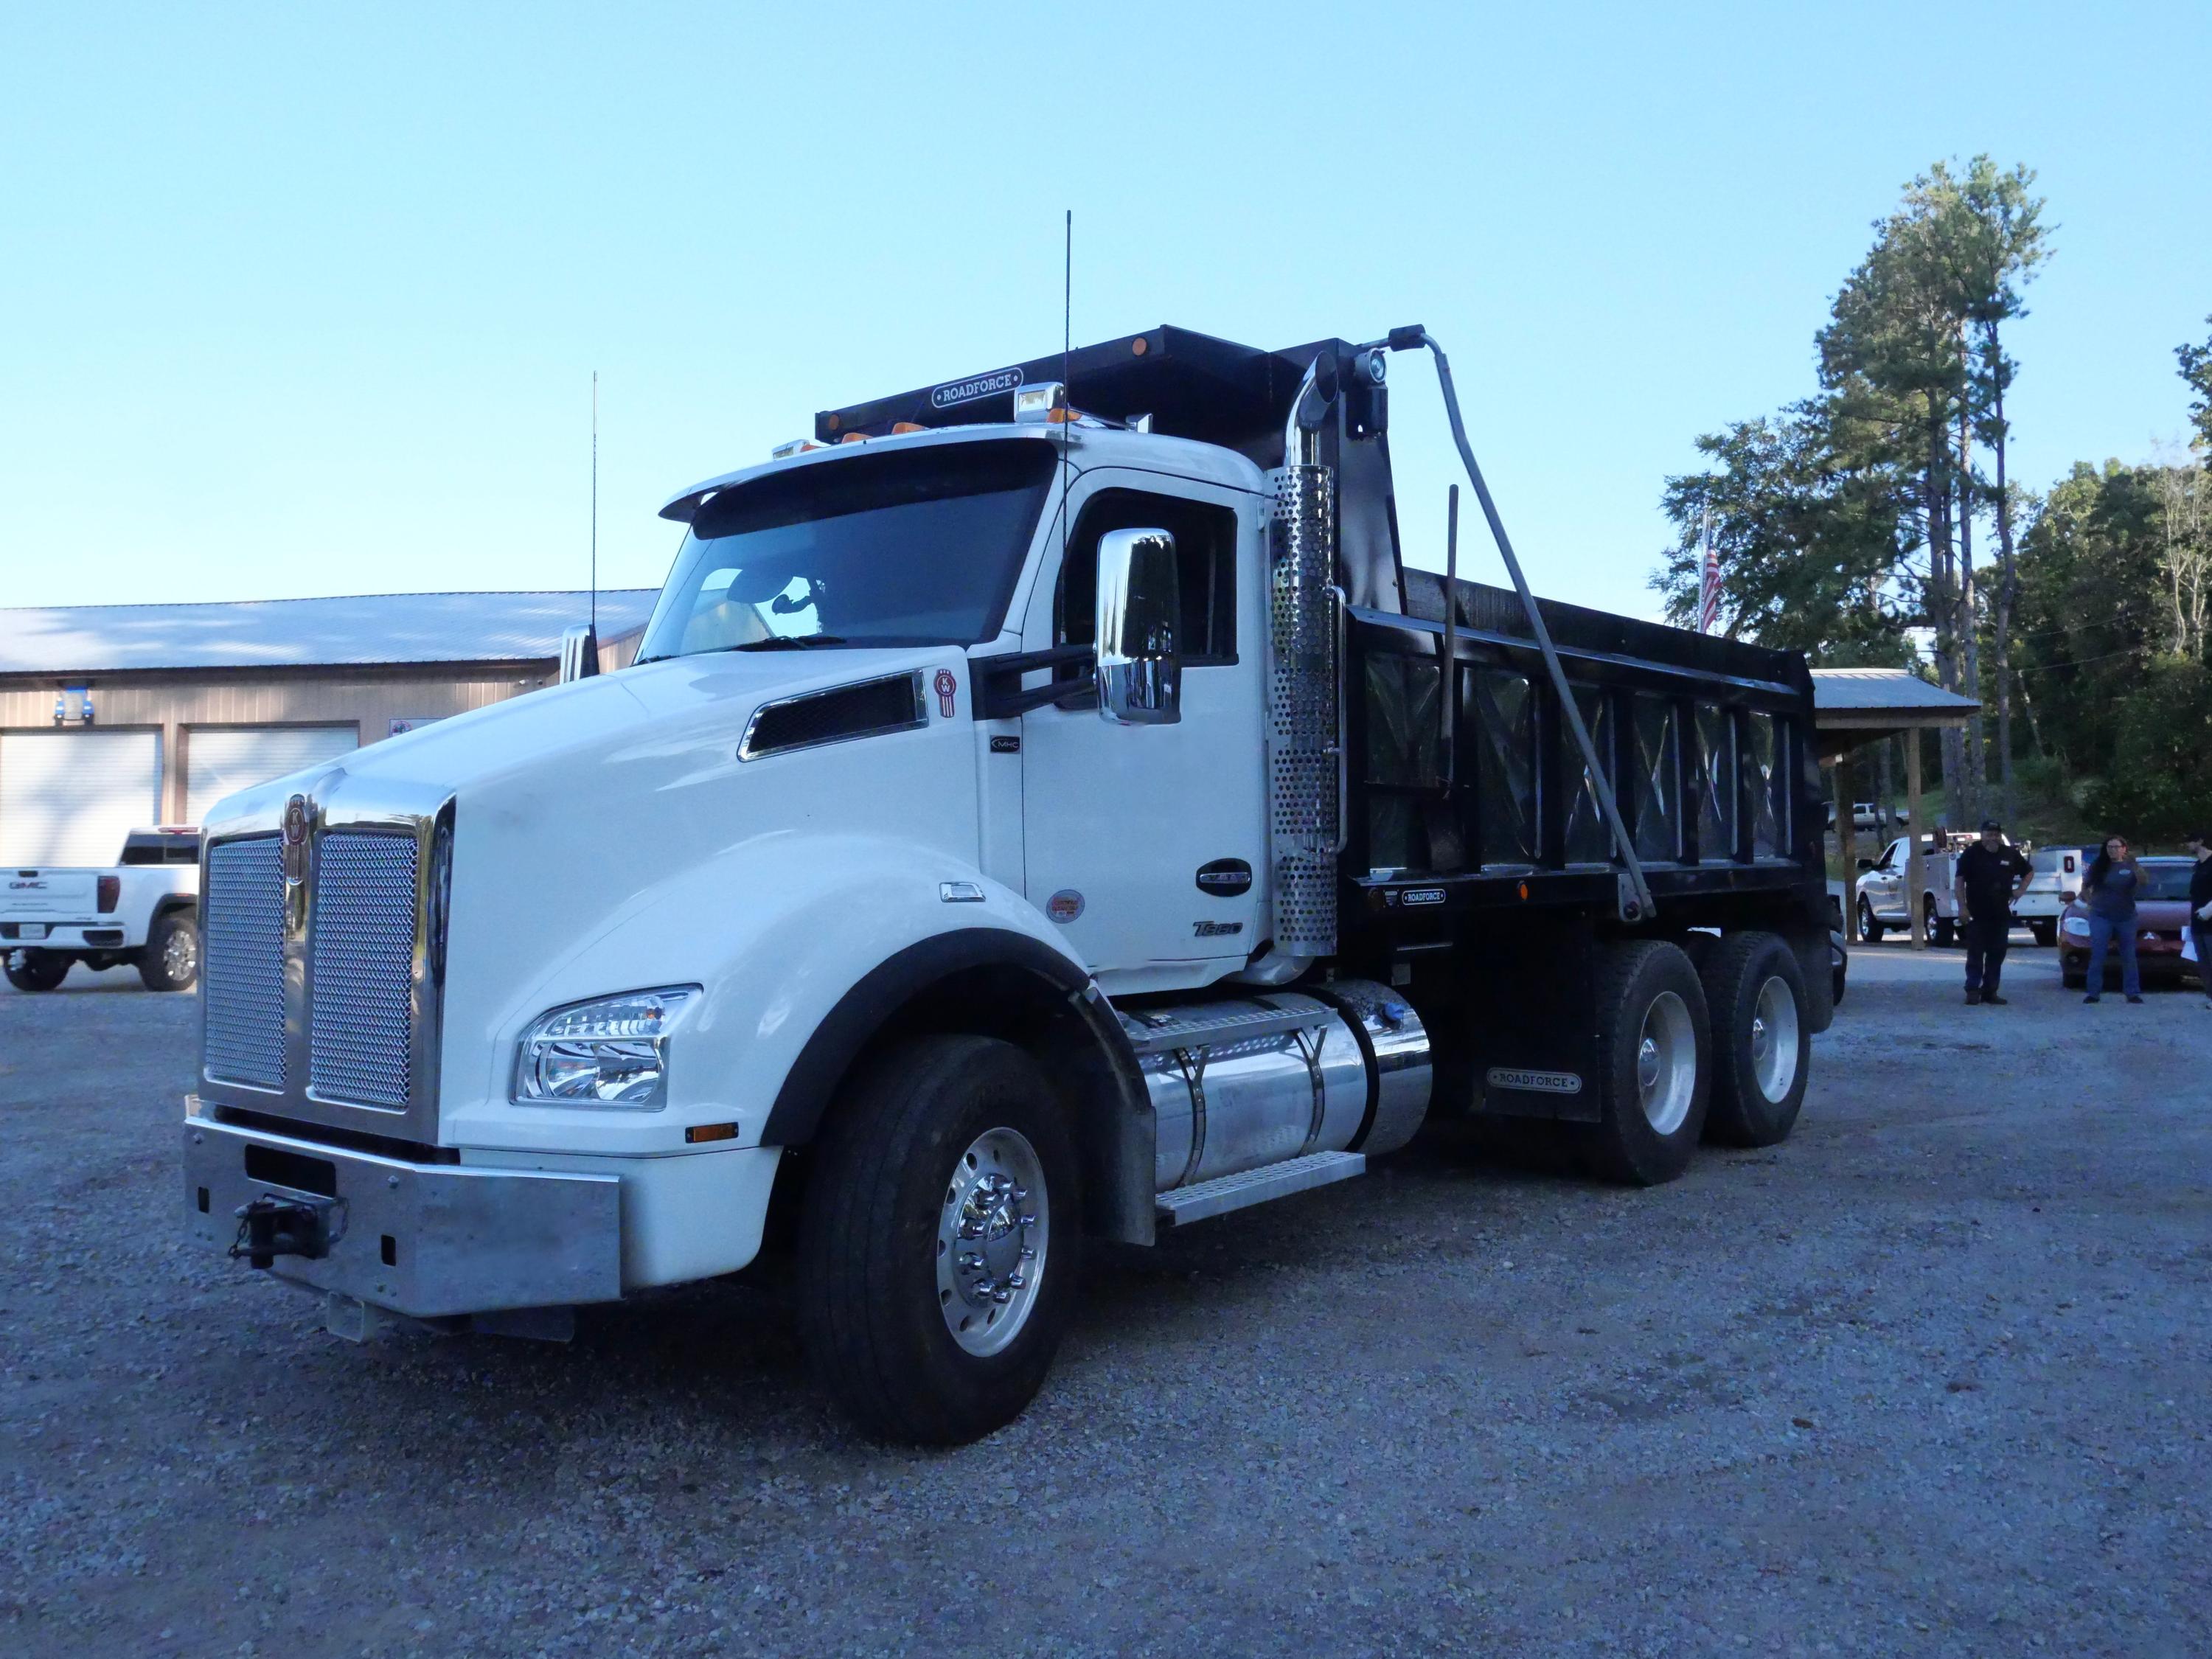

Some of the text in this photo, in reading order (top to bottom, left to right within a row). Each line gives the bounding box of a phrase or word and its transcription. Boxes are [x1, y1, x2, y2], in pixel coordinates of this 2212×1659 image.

[943, 374, 1012, 402] ROADFORCE
[998, 740, 1019, 749] MHC
[8, 881, 49, 890] GMC
[1408, 892, 1441, 902] ROADFORCE
[1499, 1073, 1568, 1088] ROADFORCE
